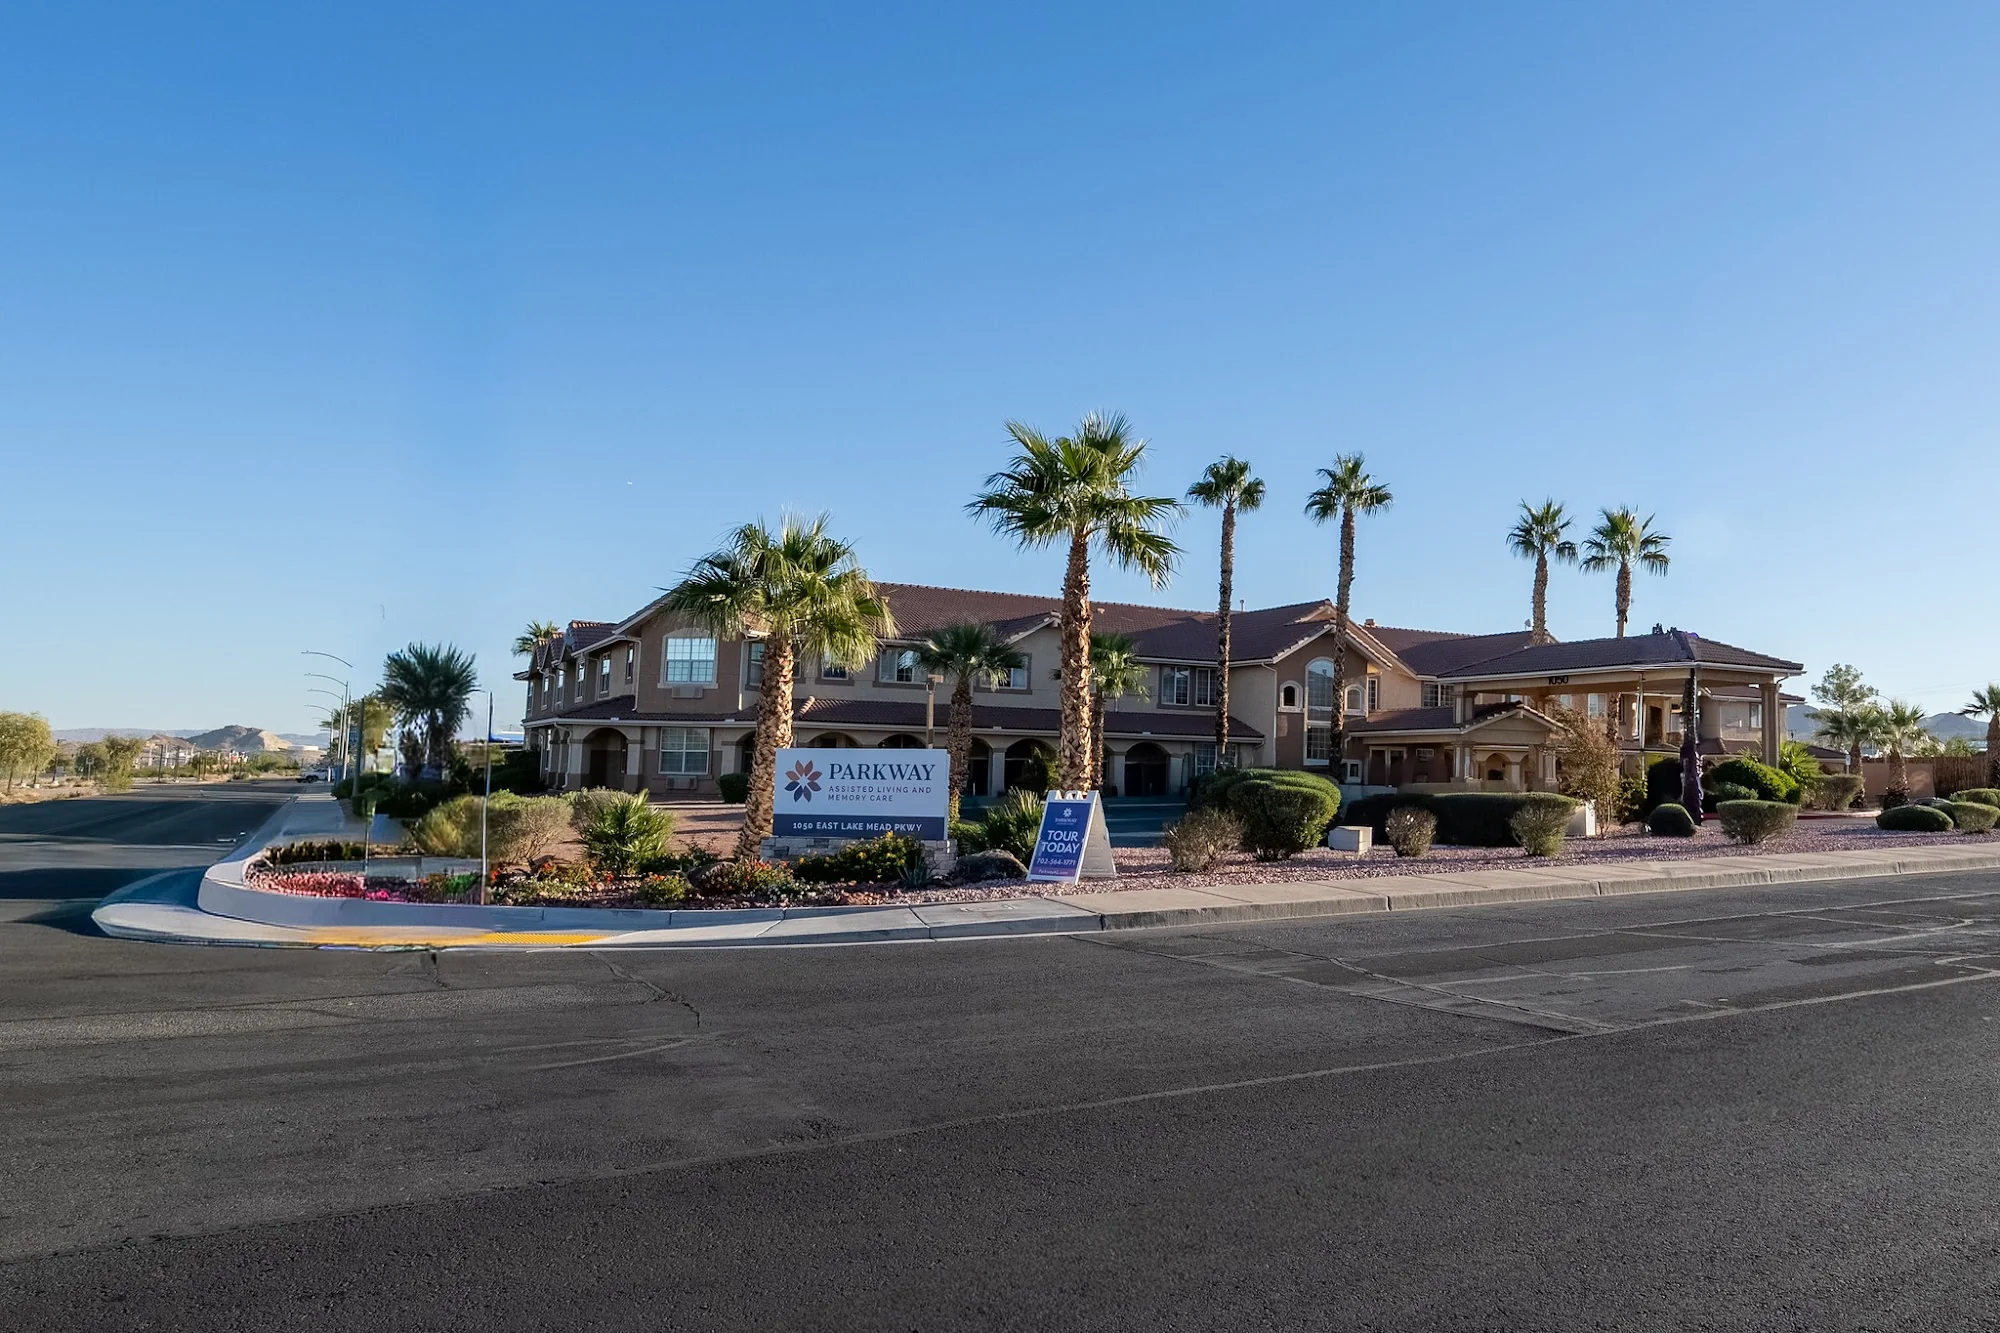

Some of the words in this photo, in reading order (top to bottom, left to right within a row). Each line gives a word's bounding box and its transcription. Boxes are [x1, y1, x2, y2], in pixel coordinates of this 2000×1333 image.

[1549, 675, 1568, 684] 1050
[828, 763, 936, 781] PARKWAY
[828, 785, 874, 793] ASSISTED
[912, 786, 932, 794] AND
[792, 822, 813, 830] 1050
[816, 821, 838, 830] EAST
[841, 822, 864, 831] LAKE
[866, 822, 892, 831] MEAD
[894, 823, 922, 832] PKWY
[1047, 830, 1078, 841] TOUR
[1041, 842, 1080, 853] TODAY
